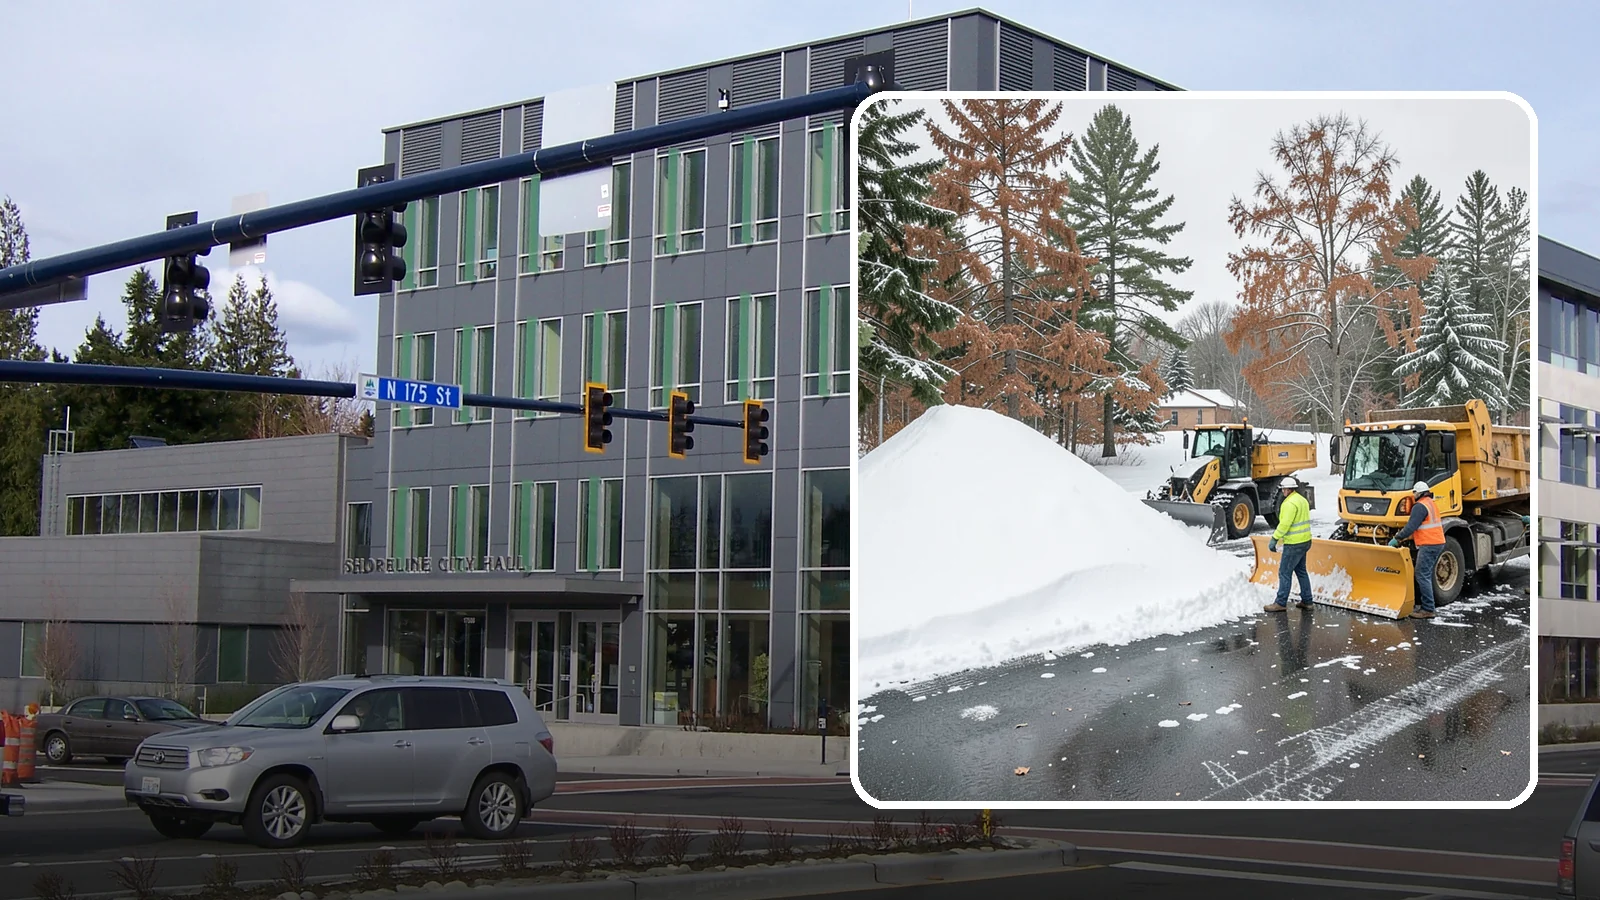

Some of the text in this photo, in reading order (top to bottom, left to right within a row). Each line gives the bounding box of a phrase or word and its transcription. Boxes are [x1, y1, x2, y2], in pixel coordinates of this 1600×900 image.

[387, 381, 451, 405] N 175 St
[344, 555, 525, 574] SHORELINE CITY HALL
